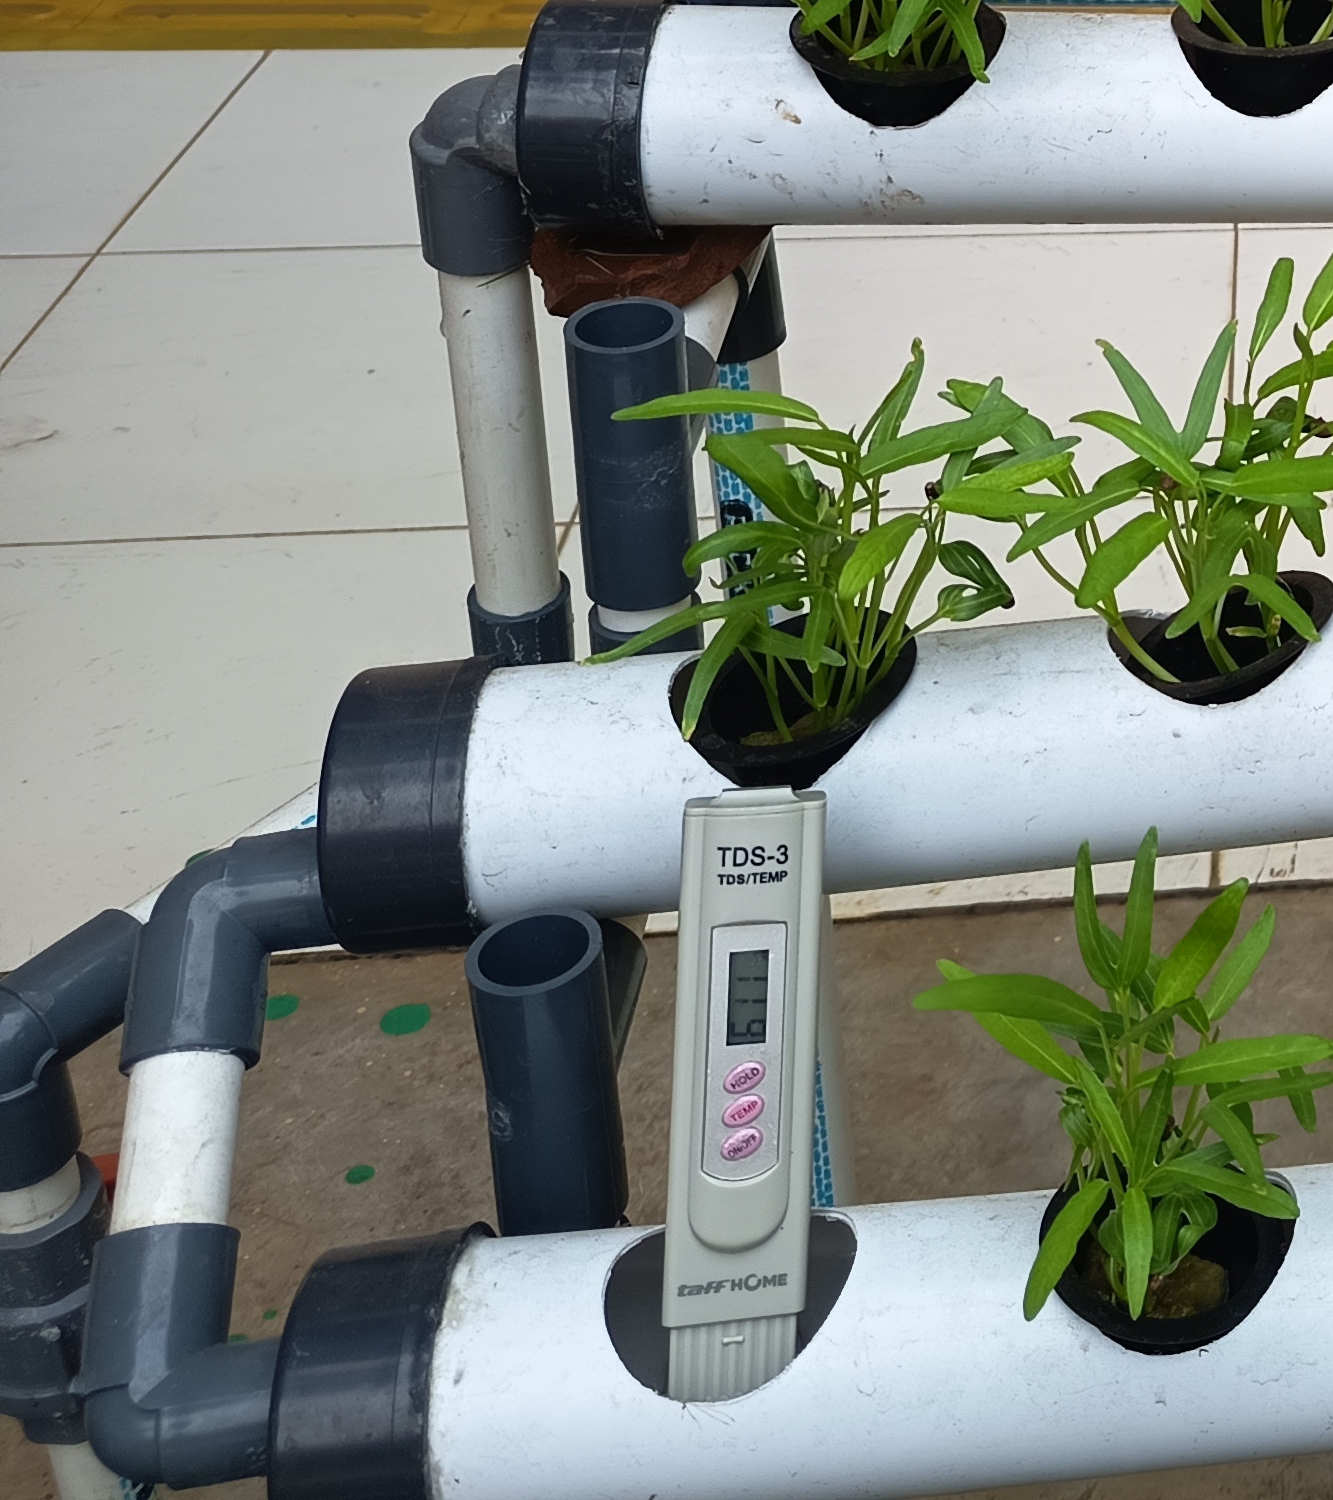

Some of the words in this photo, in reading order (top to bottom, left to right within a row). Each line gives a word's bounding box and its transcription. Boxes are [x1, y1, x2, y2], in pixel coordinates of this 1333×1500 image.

[716, 844, 789, 868] TDS-3
[717, 870, 788, 886] TDS/TEMP
[730, 1067, 760, 1090] HOLD
[730, 1100, 758, 1121] TEMP
